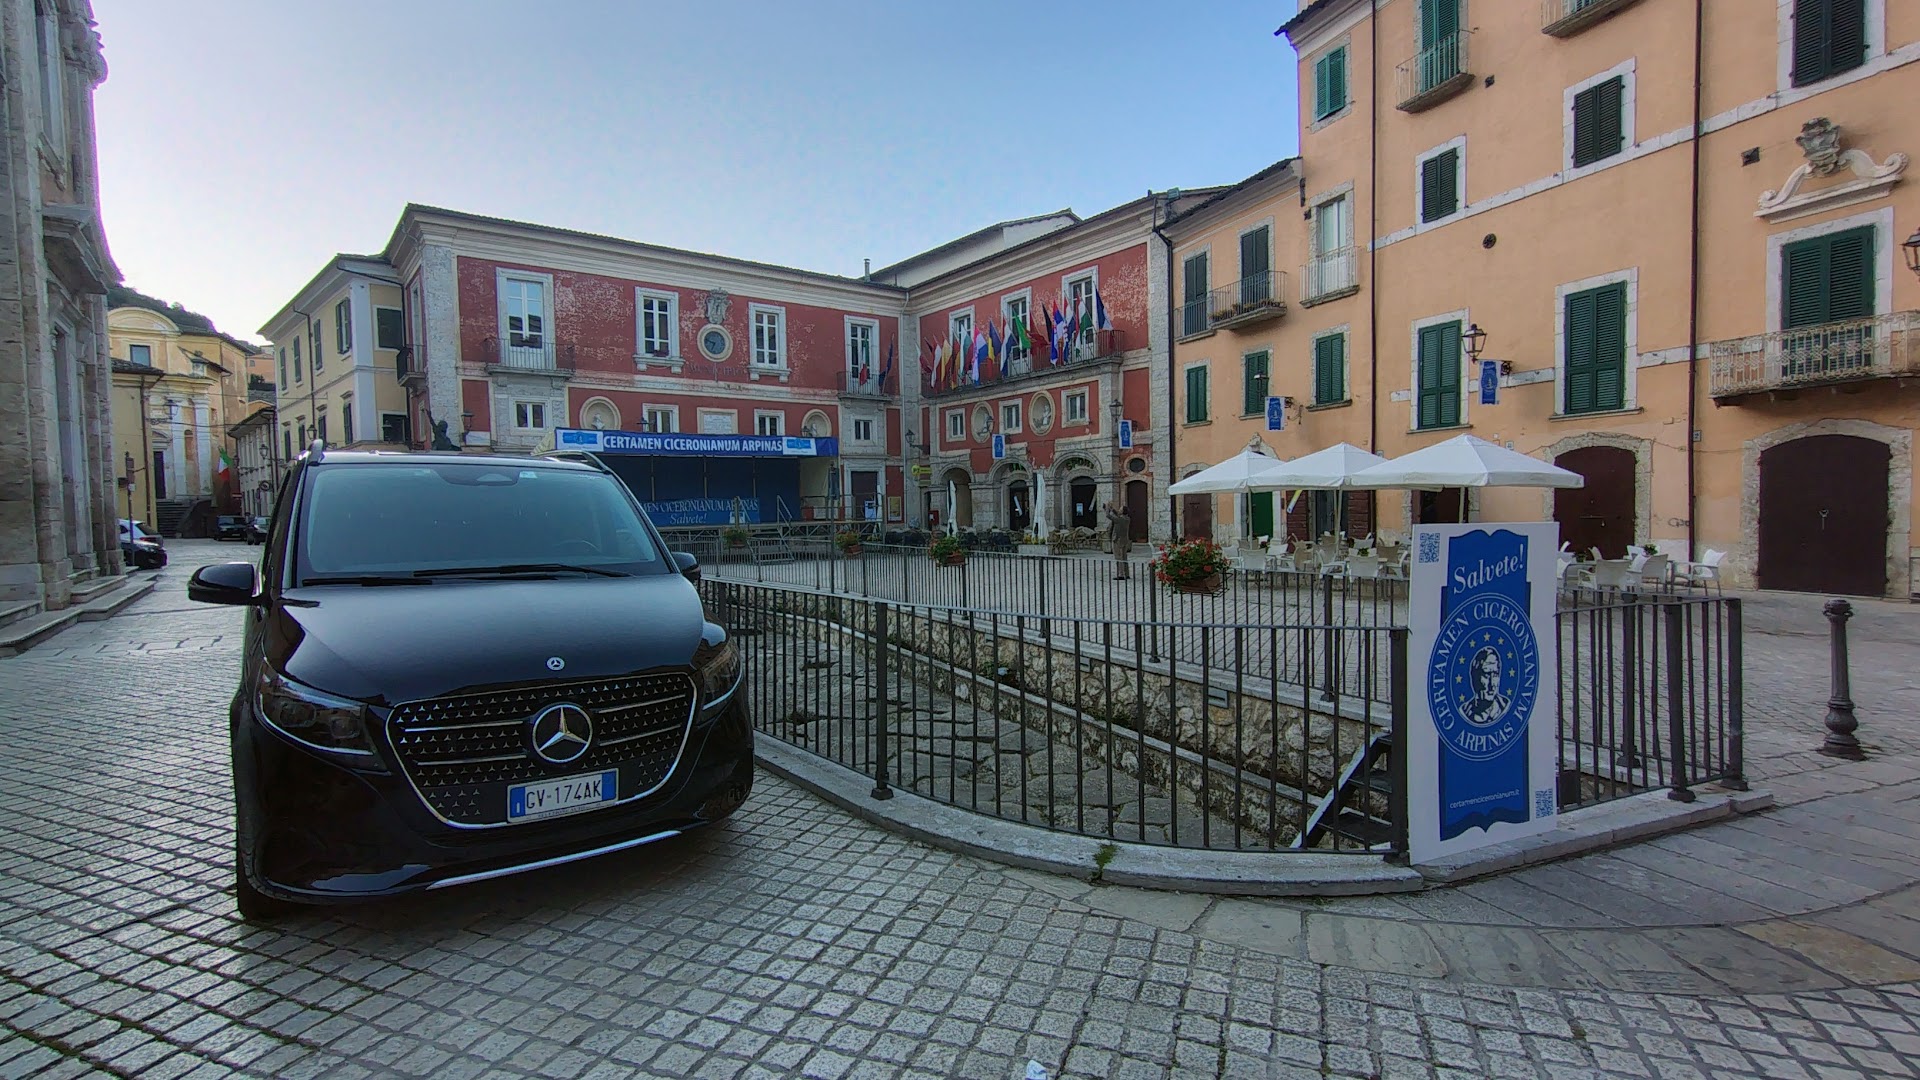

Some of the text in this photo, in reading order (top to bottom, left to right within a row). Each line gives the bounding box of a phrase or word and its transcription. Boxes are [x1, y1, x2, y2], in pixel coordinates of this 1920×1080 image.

[603, 435, 661, 450] CERTAMEN
[664, 438, 740, 451] CICERONIANUM
[742, 440, 782, 452] ARPINAS
[660, 498, 724, 512] CICERONIANUM
[670, 513, 706, 524] Salvete!
[1453, 543, 1524, 595] Salvete!
[1433, 612, 1470, 731] CERTAMEN
[1454, 722, 1514, 751] ARPINAS
